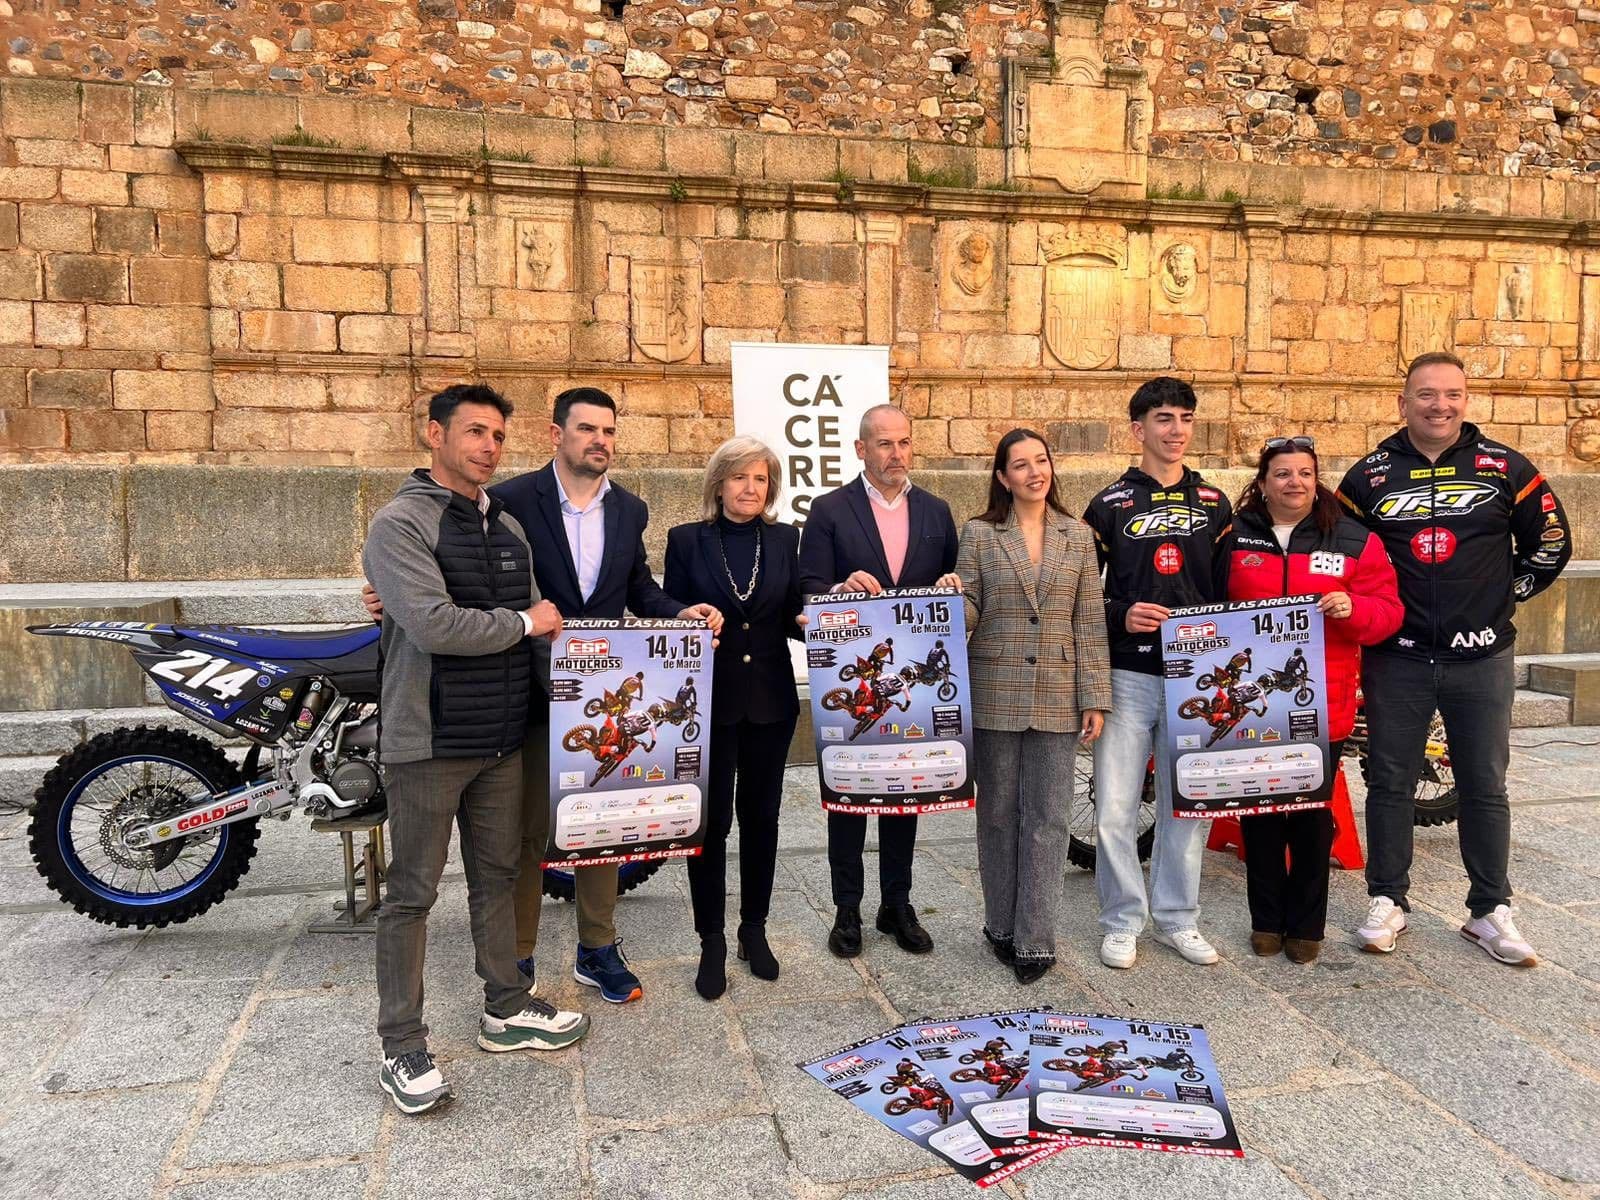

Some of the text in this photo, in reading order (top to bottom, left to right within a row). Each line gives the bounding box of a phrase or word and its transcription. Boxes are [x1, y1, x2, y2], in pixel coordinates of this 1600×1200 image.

[785, 414, 841, 448] CE
[788, 455, 843, 487] RE
[1309, 551, 1345, 577] 268
[810, 592, 866, 603] CIRCUITO
[897, 587, 955, 597] ARENAS
[891, 601, 950, 624] 14 y 15
[1169, 594, 1315, 617] CIRCUITO LAS ARENAS
[561, 619, 707, 628] CIRCUITO LAS ARENAS
[821, 613, 857, 625] ESP
[1251, 609, 1309, 635] 14 y 15
[66, 627, 132, 640] DUNLOP
[809, 628, 872, 641] MOTOCROSS
[911, 624, 950, 634] de Marzo
[1178, 625, 1214, 638] ESP
[1270, 632, 1310, 644] de Marzo
[569, 642, 608, 654] ESP
[645, 635, 701, 660] 14 y 15
[1166, 639, 1230, 653] MOTOCROSS
[555, 659, 622, 669] MOTOCROSS
[663, 659, 701, 669] de Marzo
[149, 649, 259, 700] 214
[827, 803, 899, 814] MALPARTIDA
[922, 800, 970, 812] CÁCERES
[1179, 808, 1254, 818] MALPARTIDA
[177, 808, 225, 830] GOLD
[547, 847, 696, 868] MALPARTIDA DE CÁCERES
[991, 1017, 1017, 1029] 14
[1034, 1024, 1102, 1036] MOTOCROSS
[1126, 1023, 1151, 1036] 14
[1164, 1028, 1191, 1041] 15
[1037, 1132, 1137, 1147] MALPARTIDA
